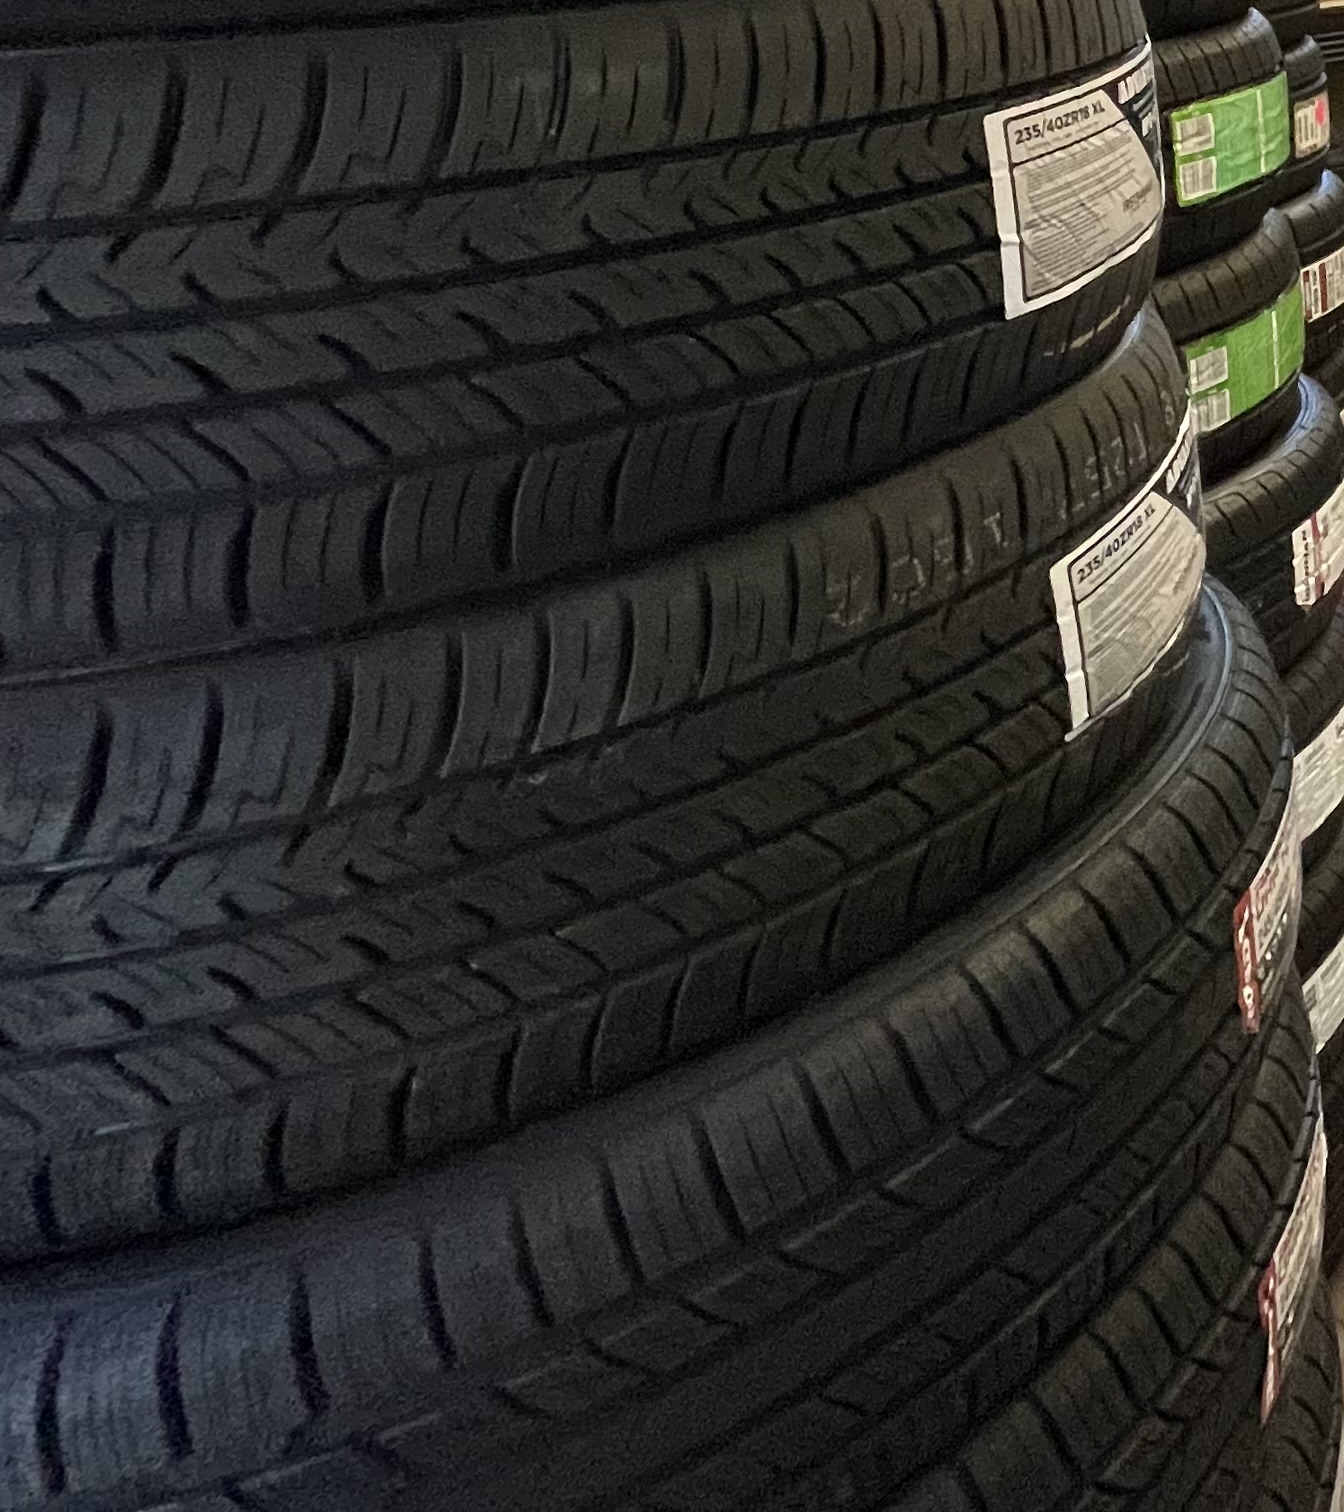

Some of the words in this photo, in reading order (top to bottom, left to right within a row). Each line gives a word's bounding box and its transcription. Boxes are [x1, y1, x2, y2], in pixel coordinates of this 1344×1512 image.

[1014, 106, 1091, 145] 235/40ZR18
[1092, 100, 1106, 116] XL
[1076, 517, 1145, 584] 235/40ZR18
[1144, 504, 1156, 519] XL
